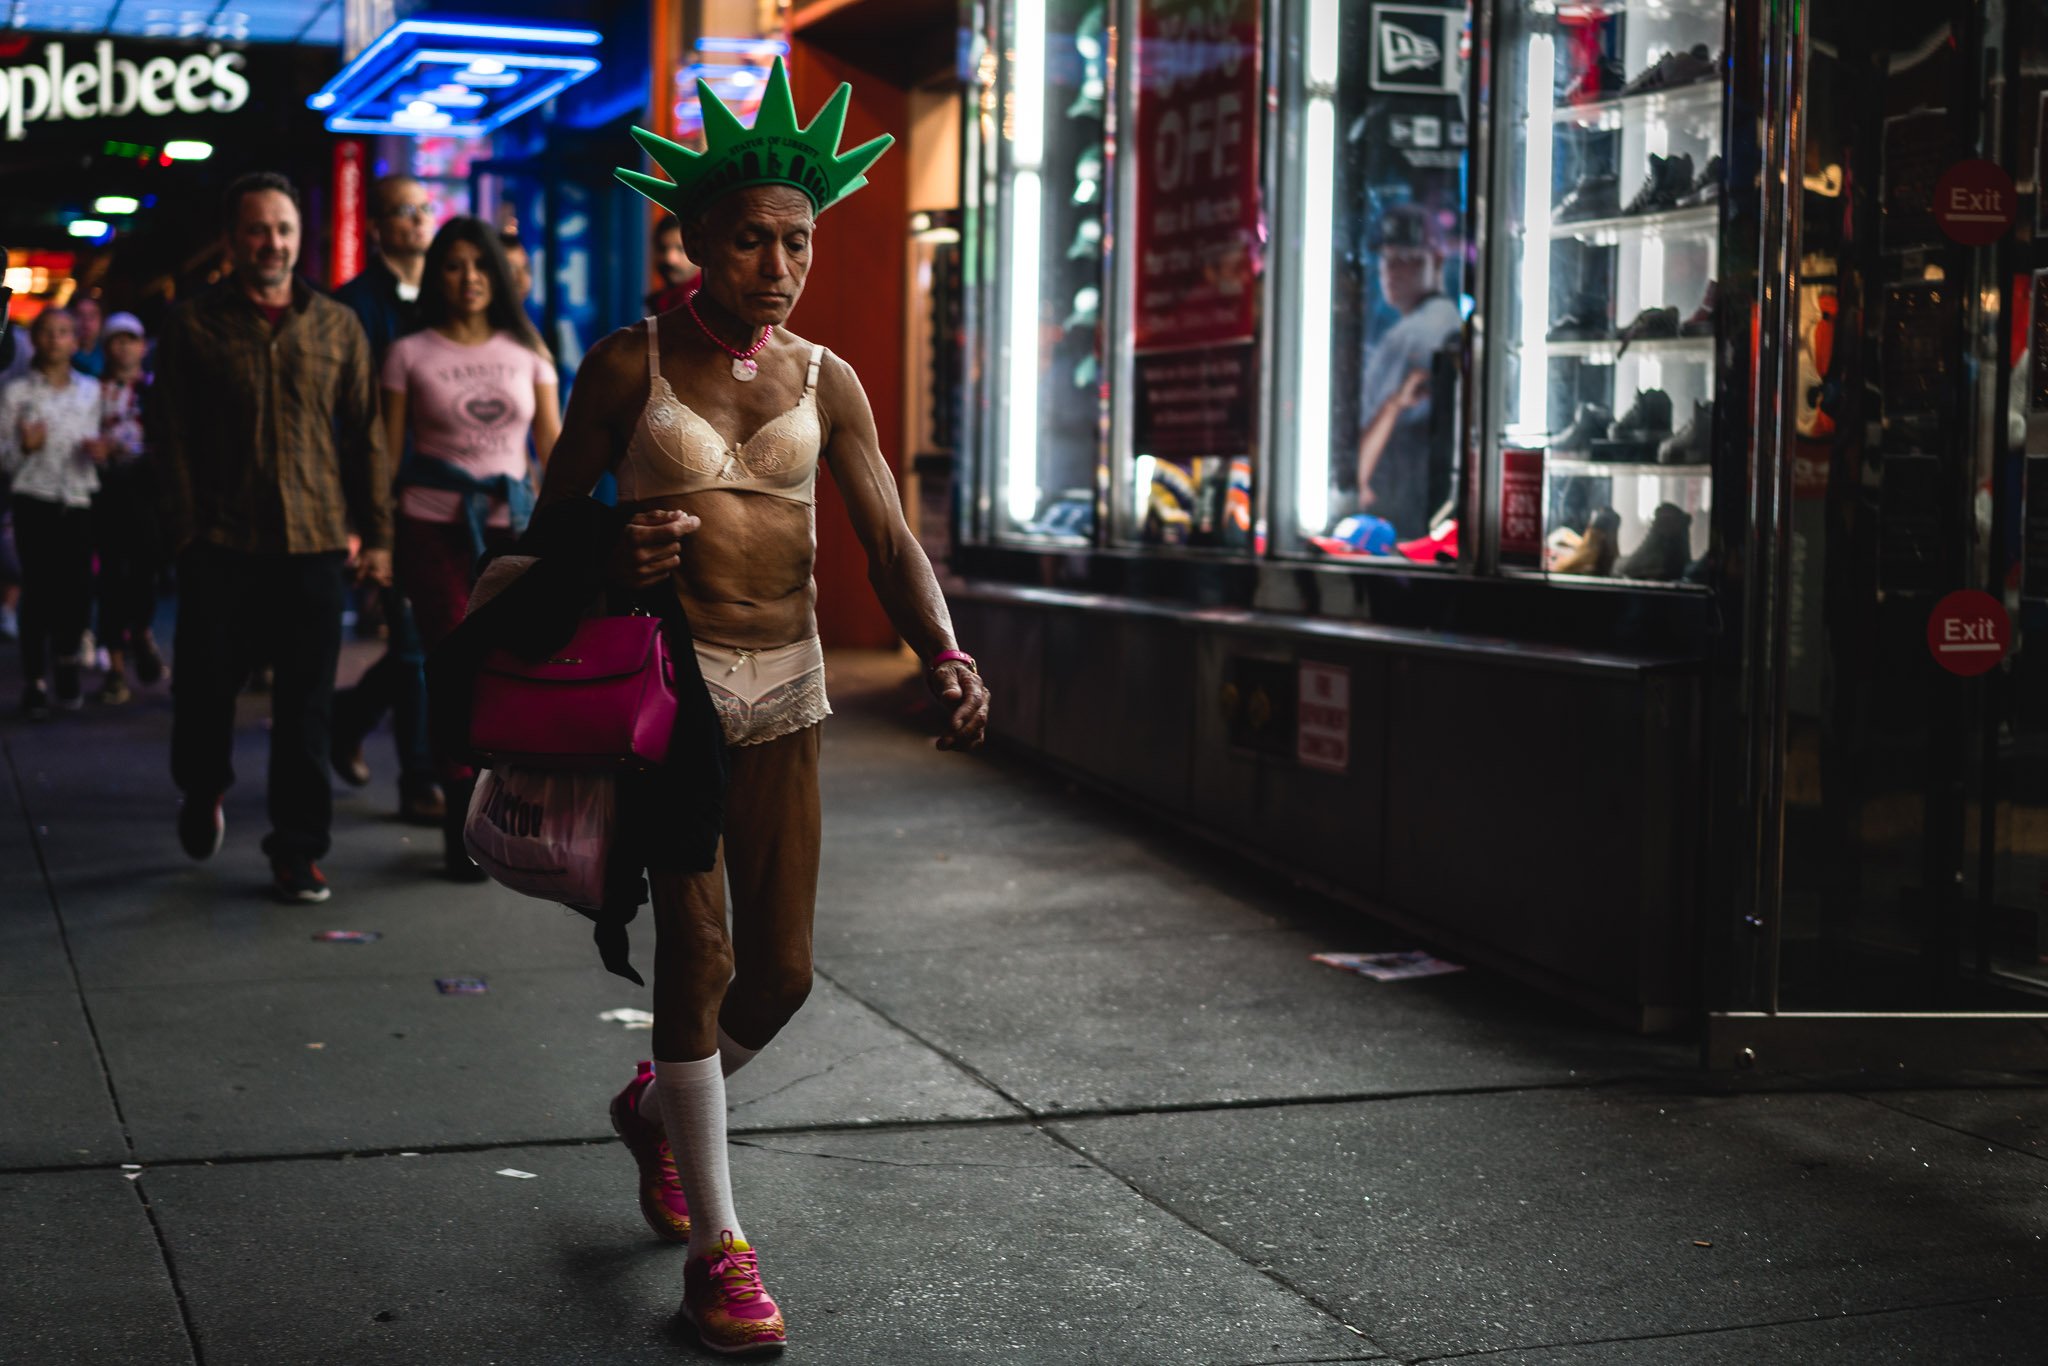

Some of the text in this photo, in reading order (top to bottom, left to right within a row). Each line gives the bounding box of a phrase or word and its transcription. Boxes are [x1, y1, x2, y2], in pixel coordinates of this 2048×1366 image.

[0, 38, 250, 141] plebee's
[728, 135, 819, 158] STATUE OF LIBERTY
[1950, 186, 2002, 211] Exit
[1944, 617, 1995, 641] Exit
